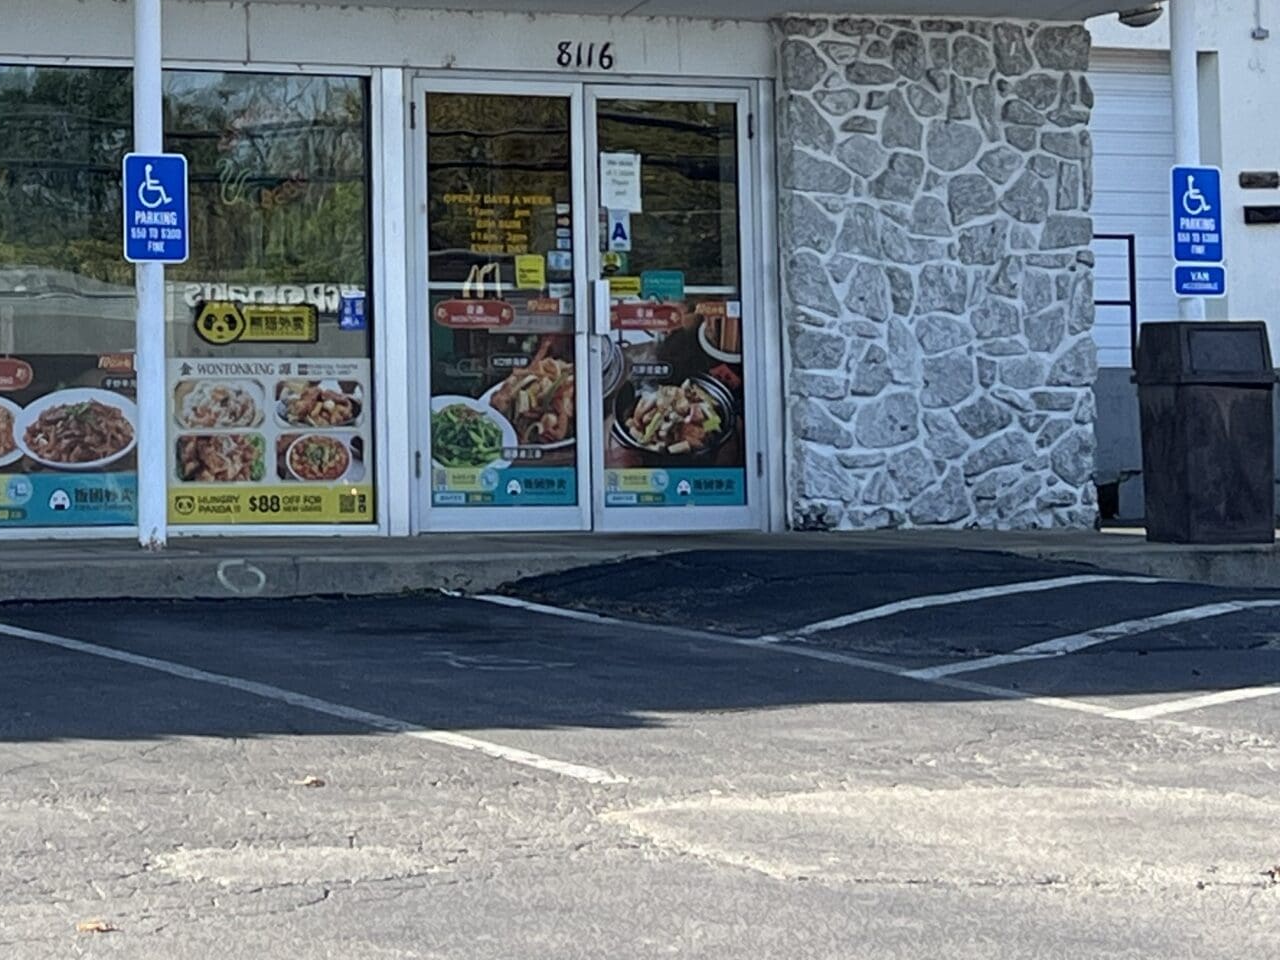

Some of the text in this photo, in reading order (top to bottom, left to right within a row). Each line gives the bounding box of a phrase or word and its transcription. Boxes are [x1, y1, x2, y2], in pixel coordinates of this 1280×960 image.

[556, 41, 613, 70] 8116
[134, 210, 177, 226] PARKING
[612, 222, 628, 241] A
[147, 241, 165, 253] FINE
[1190, 271, 1210, 281] VAN
[196, 363, 275, 376] WONTONKING
[248, 494, 281, 513] $88
